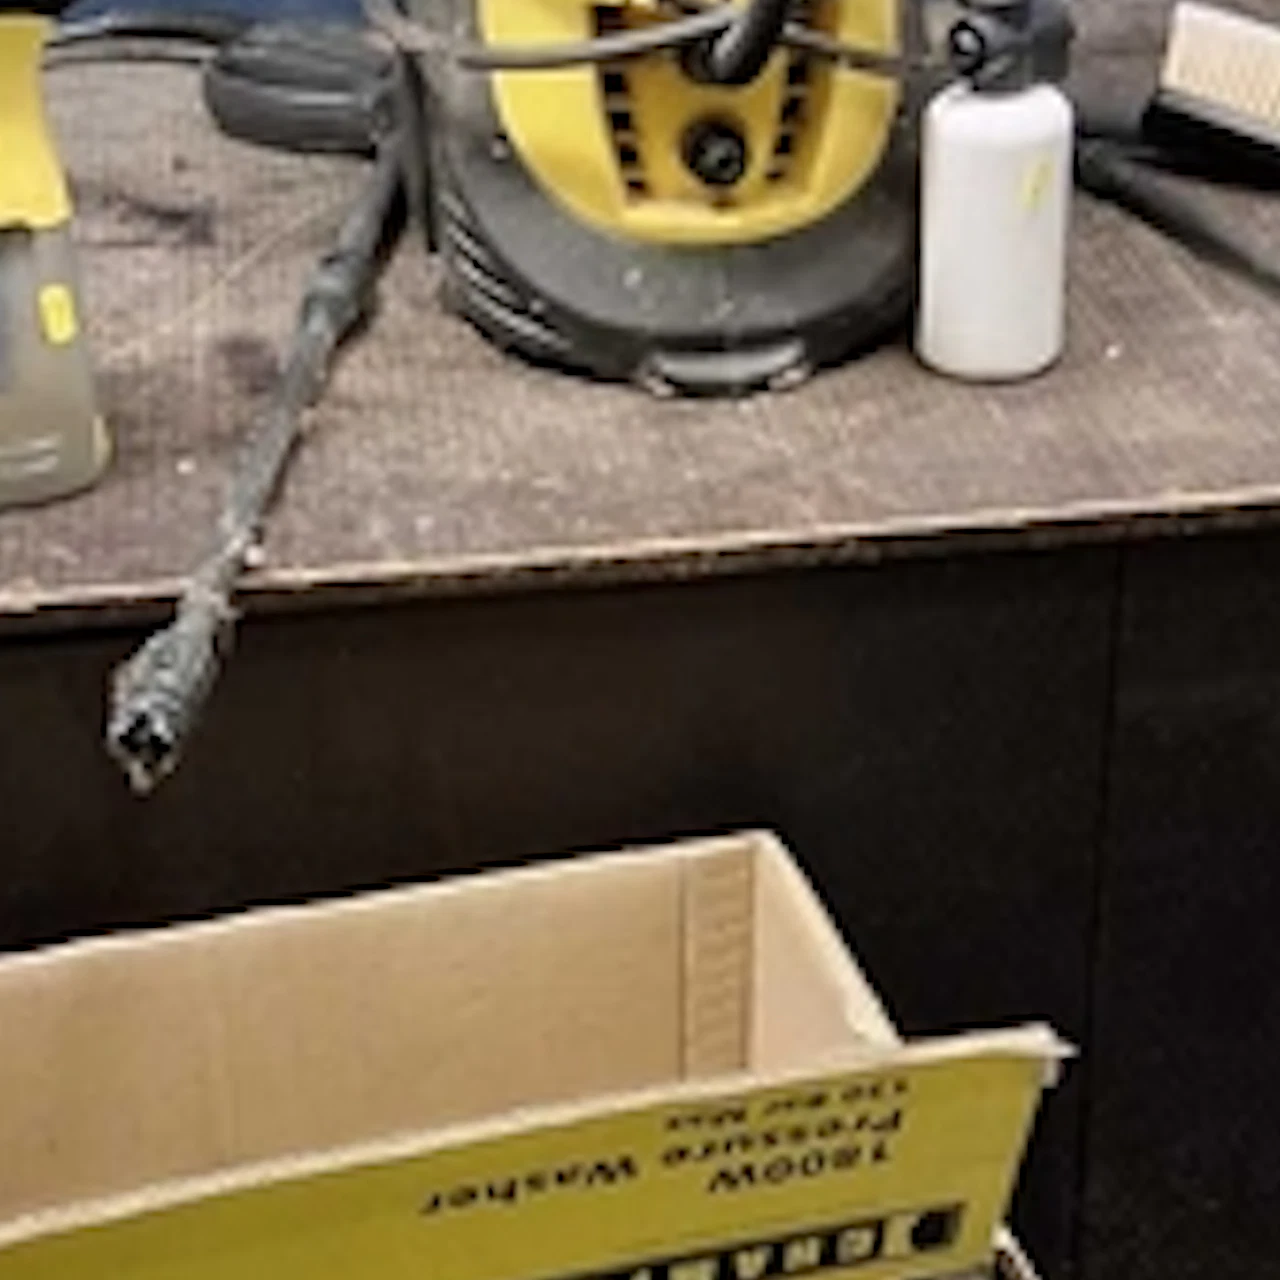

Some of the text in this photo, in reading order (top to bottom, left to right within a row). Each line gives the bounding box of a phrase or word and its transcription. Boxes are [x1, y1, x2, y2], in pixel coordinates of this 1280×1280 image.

[420, 1109, 904, 1215] Pressure Washer
[705, 1140, 894, 1193] 1800W
